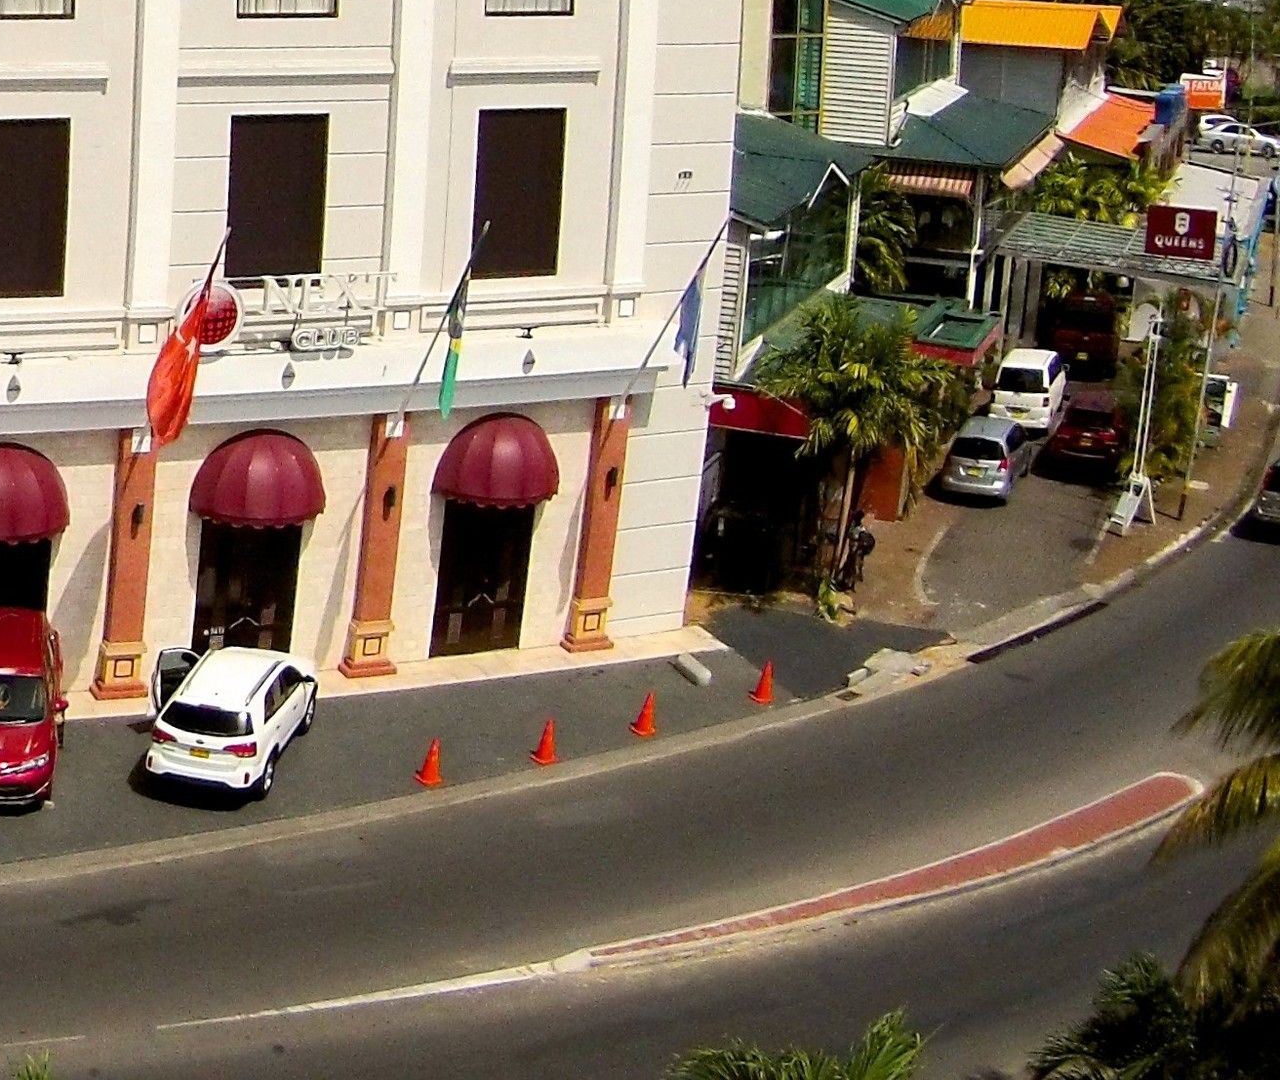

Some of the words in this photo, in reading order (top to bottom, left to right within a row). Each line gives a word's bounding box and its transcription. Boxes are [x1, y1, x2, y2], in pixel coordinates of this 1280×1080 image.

[1154, 234, 1206, 250] QUEENS
[259, 272, 398, 316] NEXT
[294, 326, 361, 350] CLUB
